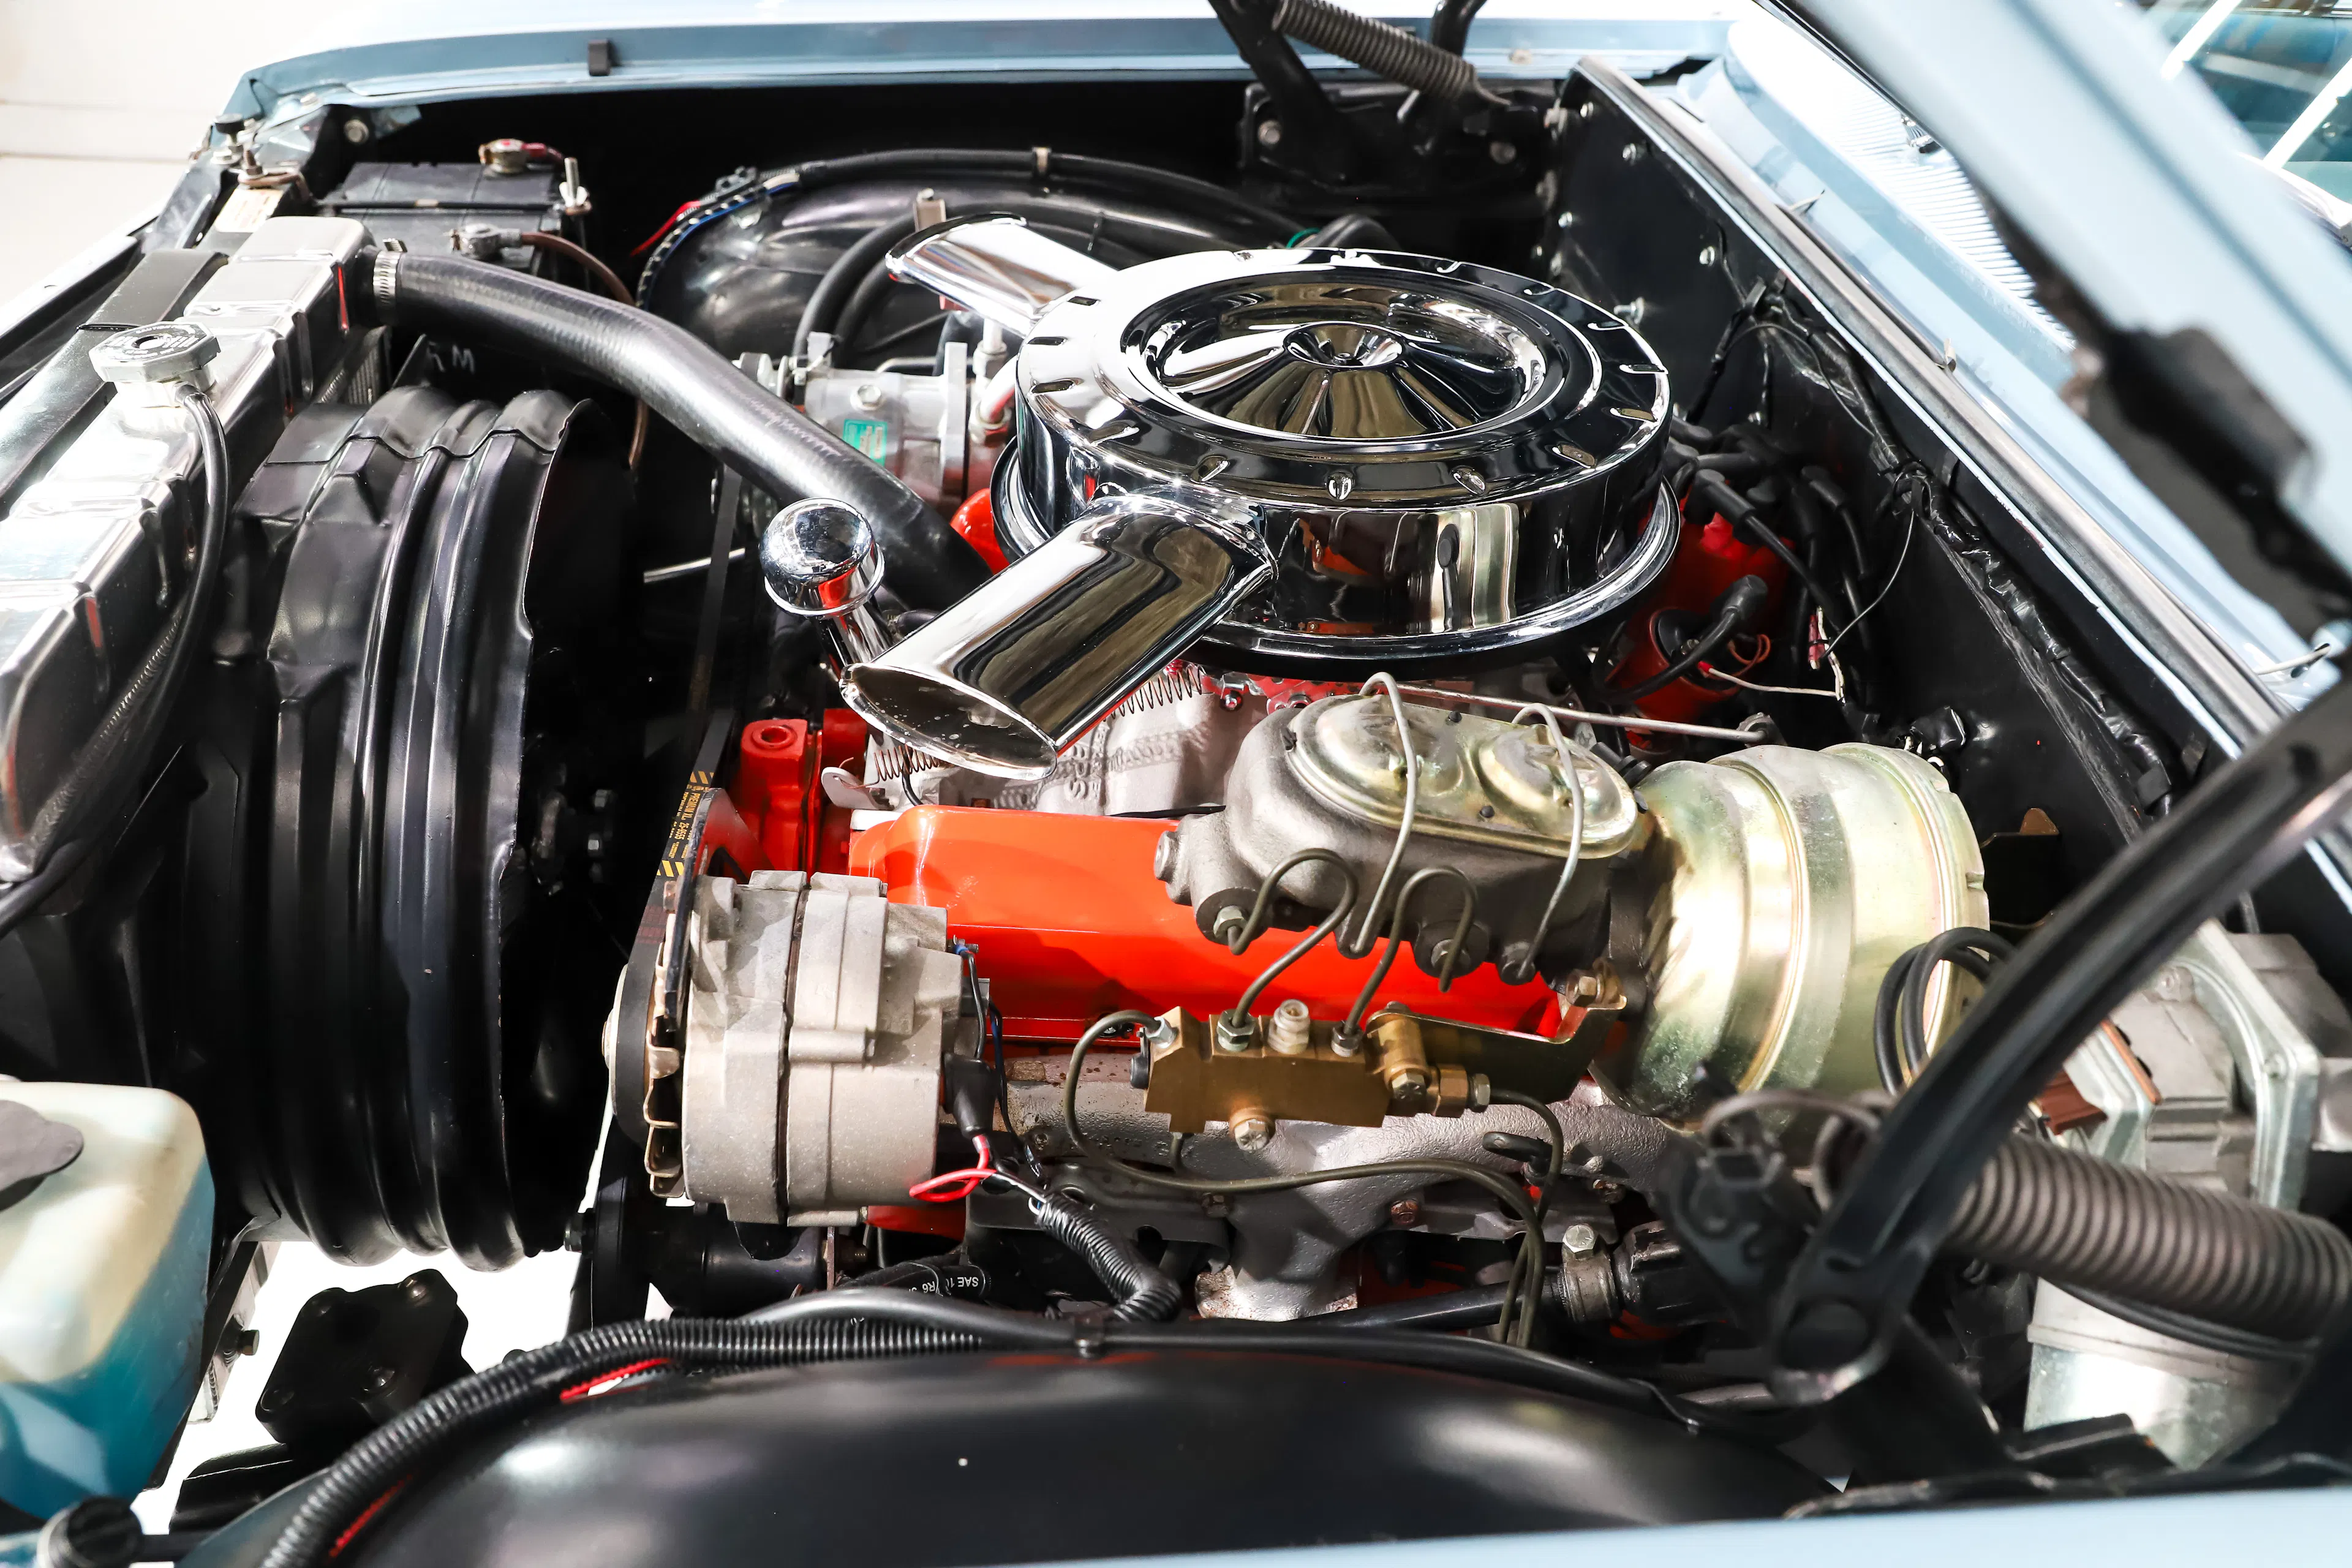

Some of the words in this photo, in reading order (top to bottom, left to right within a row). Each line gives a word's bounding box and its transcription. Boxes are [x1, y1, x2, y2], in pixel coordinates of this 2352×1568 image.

[684, 793, 700, 813] PREMIUM
[674, 822, 690, 840] 25-9555
[957, 1276, 979, 1287] SAE
